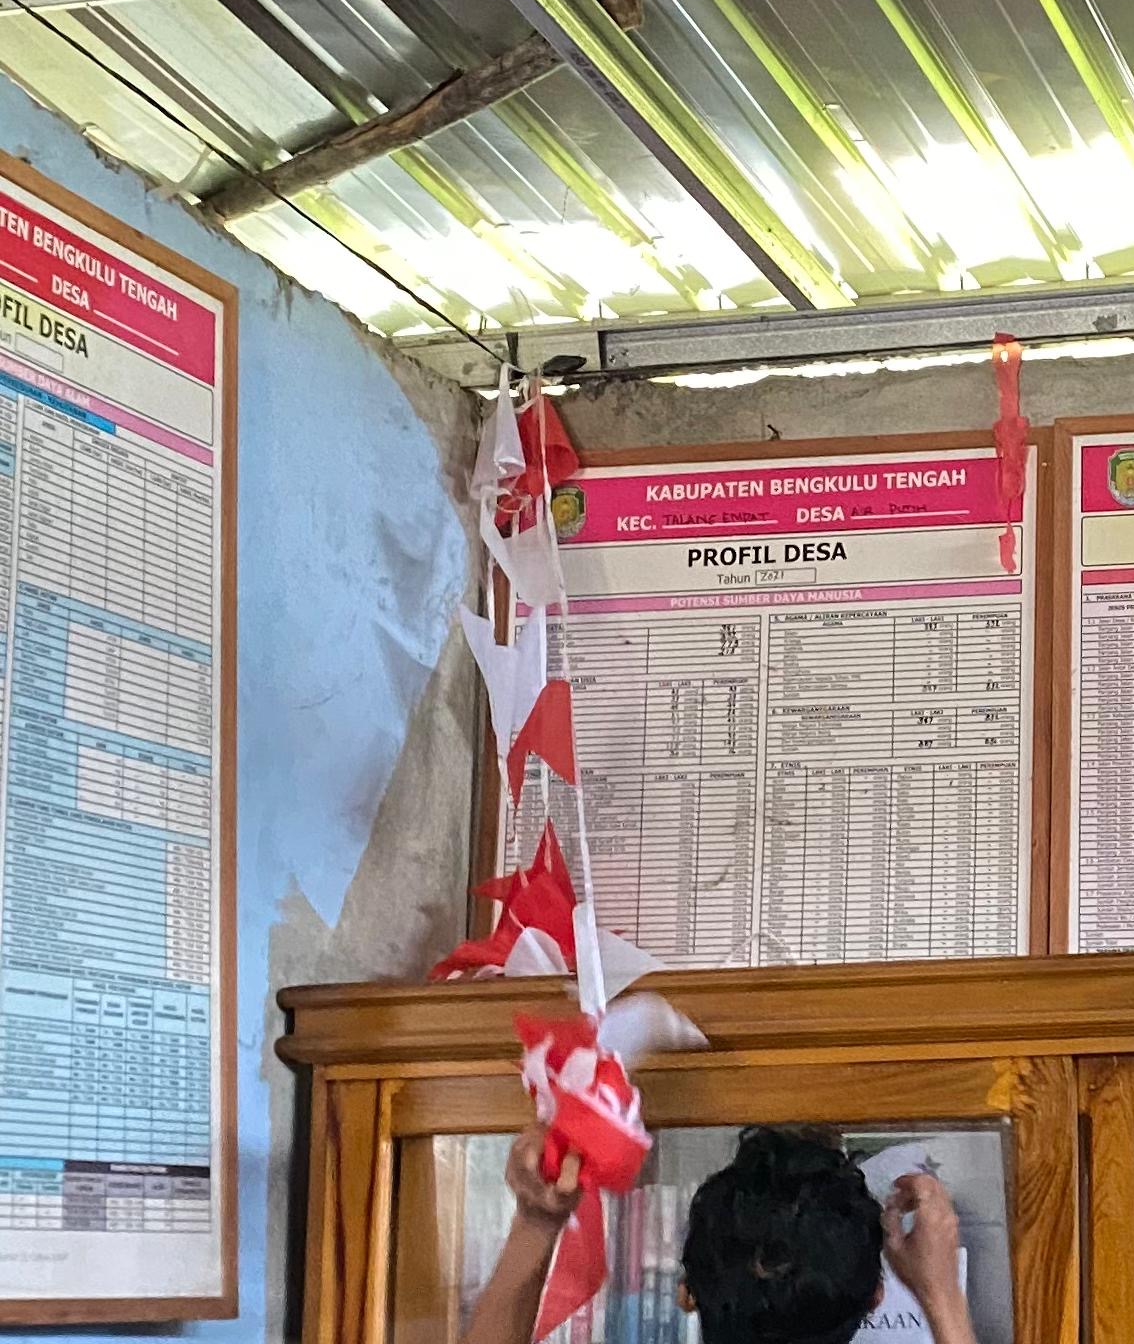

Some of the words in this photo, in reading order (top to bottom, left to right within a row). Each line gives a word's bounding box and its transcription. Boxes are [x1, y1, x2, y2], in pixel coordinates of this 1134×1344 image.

[33, 226, 115, 287] BENGKULU
[119, 273, 177, 321] TENGAH
[52, 274, 90, 311] DESA
[40, 313, 88, 358] DESA
[646, 480, 763, 502] KABUPATEN
[770, 473, 878, 496] BENGKULU
[883, 468, 966, 489] TENGAH
[617, 516, 657, 531] KEC.
[796, 506, 845, 523] DESA
[688, 545, 776, 568] PROFIL
[784, 542, 847, 563] DESA
[717, 573, 750, 585] Tahun
[671, 595, 720, 608] POTENSI
[724, 594, 770, 606] SUMBER
[774, 592, 804, 604] DAYA
[808, 589, 863, 601] MANUSIA
